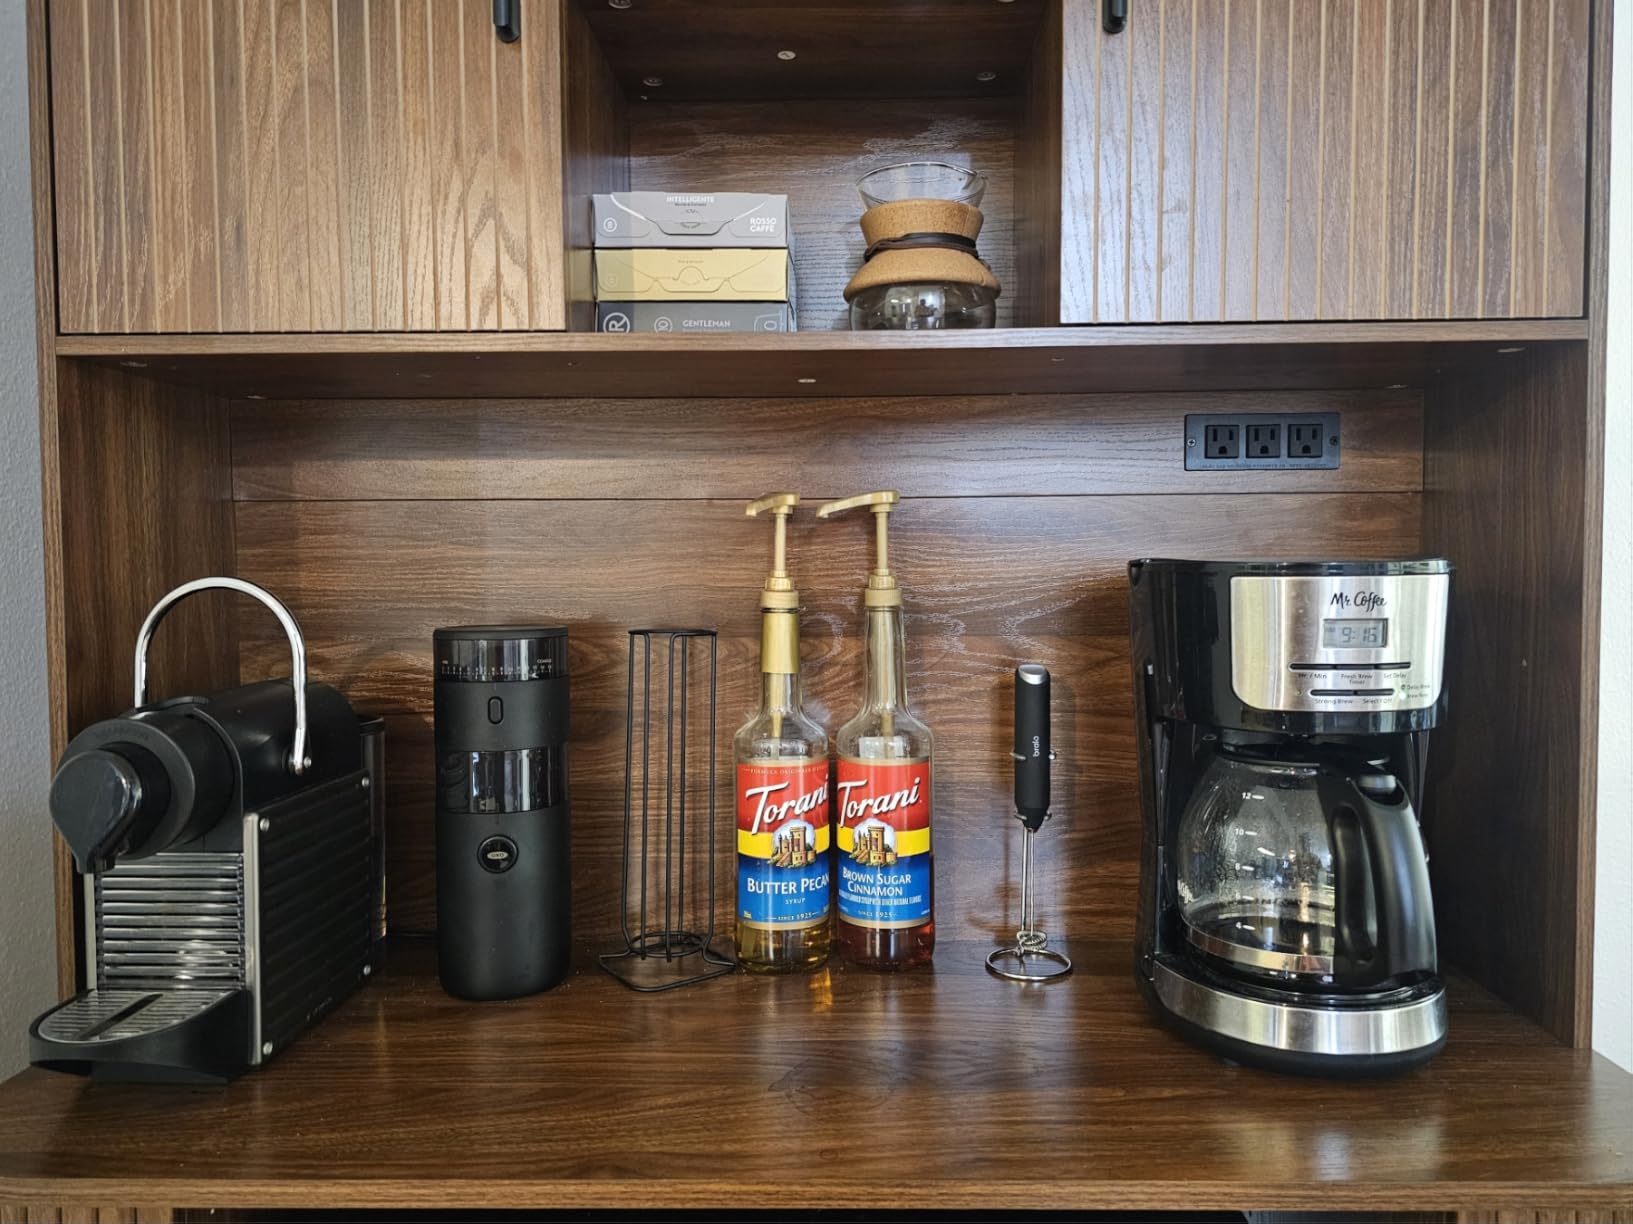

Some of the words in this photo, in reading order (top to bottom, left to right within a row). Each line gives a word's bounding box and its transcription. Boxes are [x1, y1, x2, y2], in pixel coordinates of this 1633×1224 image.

[750, 217, 777, 225] ROSSO
[682, 319, 731, 328] GENTLEMAN
[1330, 591, 1351, 609] Mr.
[1353, 590, 1388, 612] Coffee
[1341, 626, 1377, 643] 9:16
[838, 776, 920, 828] Torani
[1242, 792, 1251, 800] 12
[745, 774, 829, 835] Torani
[843, 866, 874, 884] BROWN
[876, 873, 912, 885] SUGAR
[747, 877, 797, 896] BUTTER
[848, 881, 903, 897] CINNAMON
[796, 911, 812, 920] 1925
[1235, 921, 1242, 929] 4
